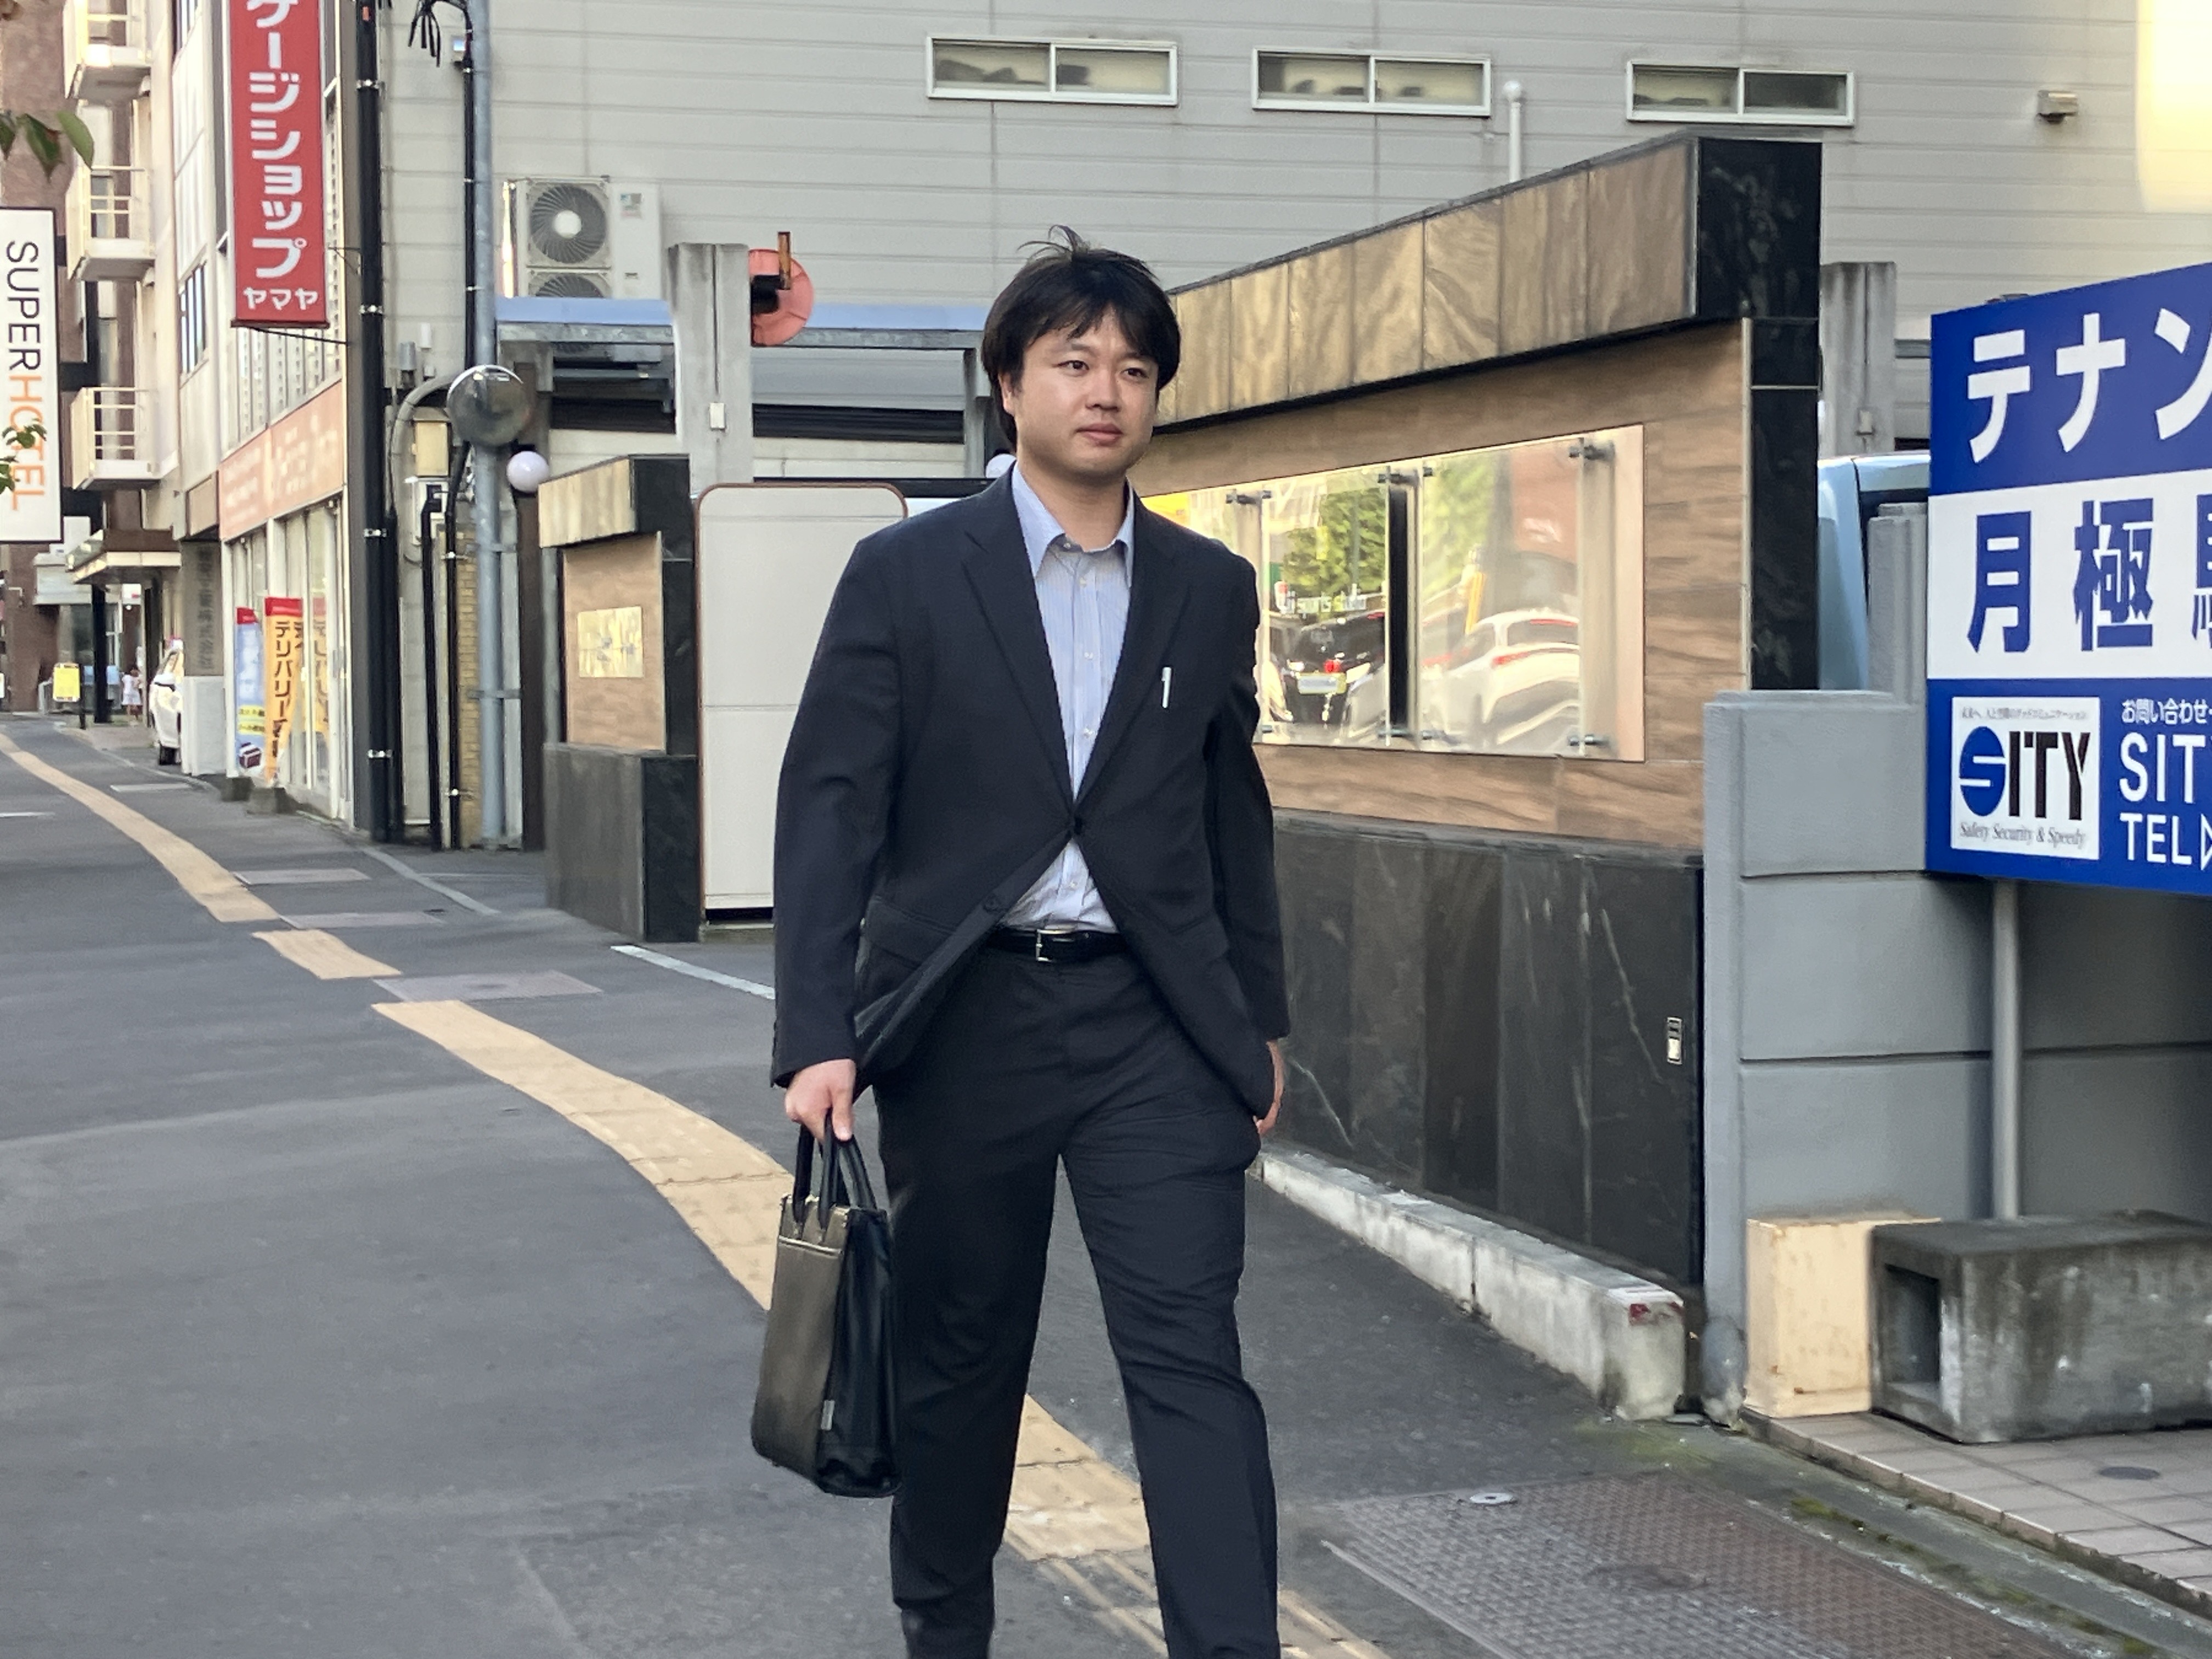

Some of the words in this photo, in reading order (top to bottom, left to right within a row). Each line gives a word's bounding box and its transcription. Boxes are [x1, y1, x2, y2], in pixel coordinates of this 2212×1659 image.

[243, 287, 318, 310] ヤマヤ
[1968, 308, 2212, 463] テナン
[1967, 494, 2212, 653] 月極
[2122, 697, 2212, 725] お問い合わせ
[1959, 726, 2091, 820] SITY
[2119, 732, 2212, 804] SIT
[1993, 823, 2034, 845] Security
[2036, 827, 2045, 843] &
[2119, 812, 2192, 865] TEL
